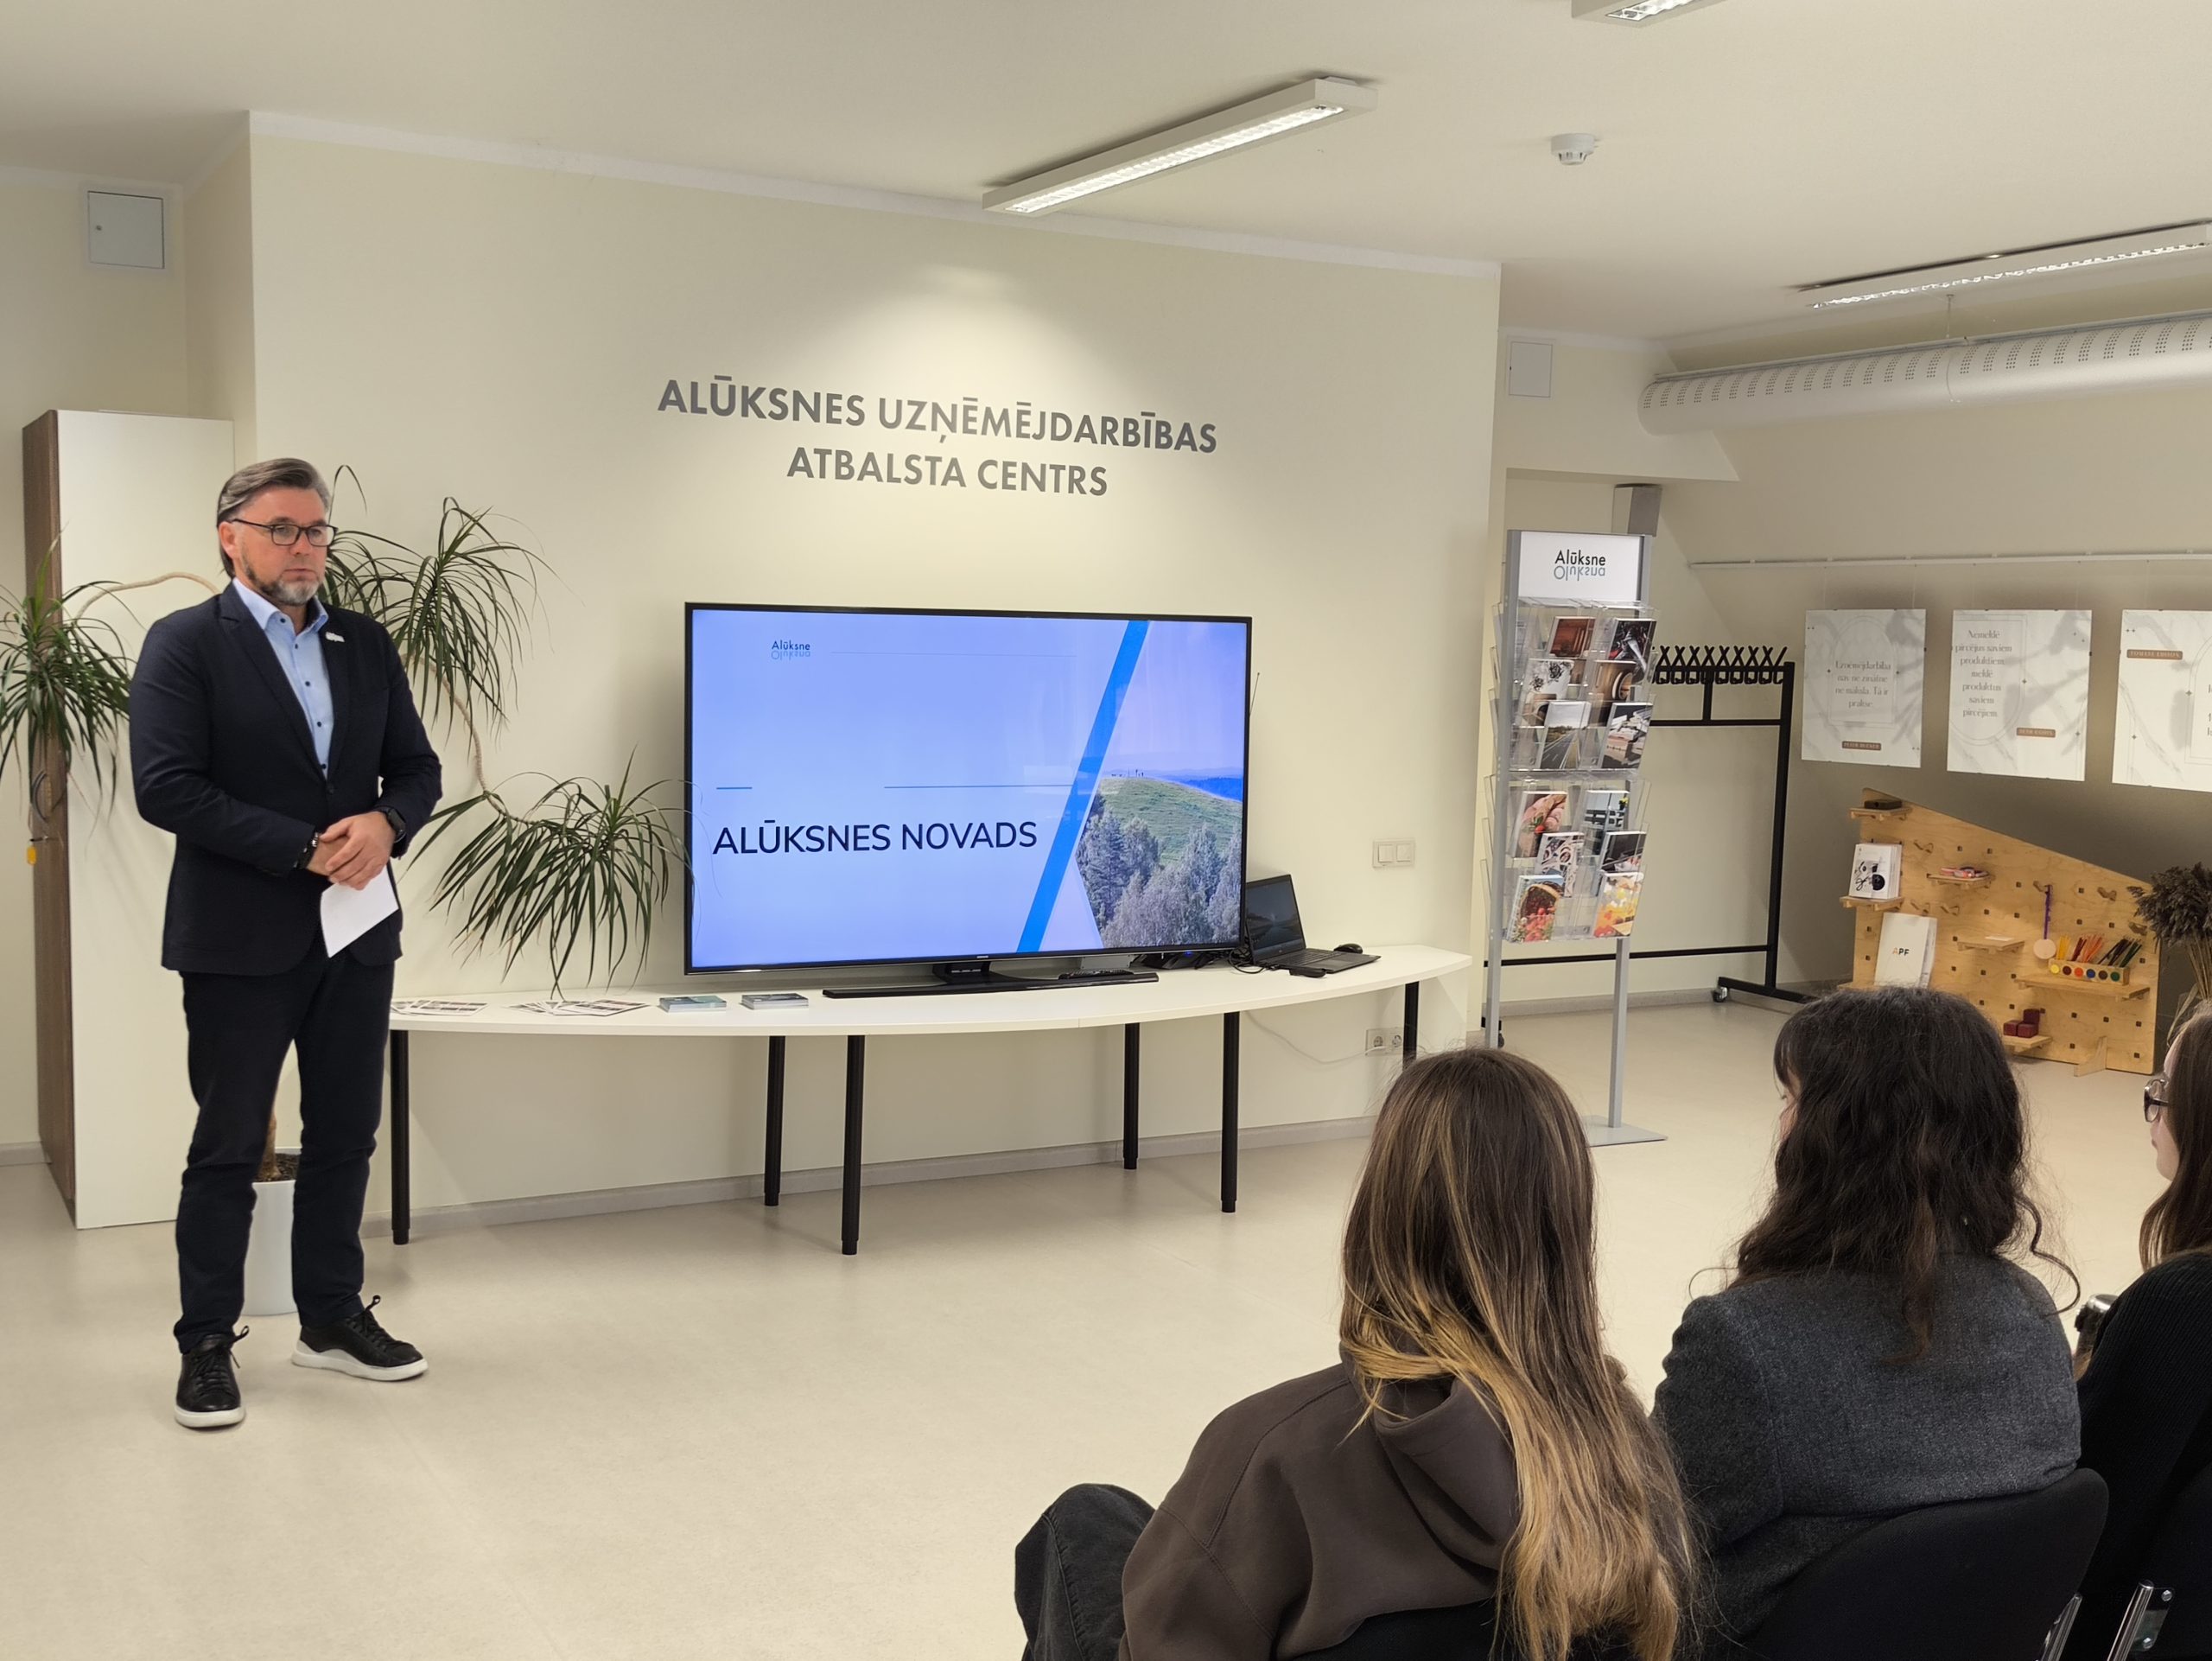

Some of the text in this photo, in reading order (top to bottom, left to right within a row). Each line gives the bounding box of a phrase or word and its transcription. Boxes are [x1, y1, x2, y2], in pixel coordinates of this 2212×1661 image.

[658, 374, 1217, 455] ALŪKSNES UZŅĒMĒJDARBĪBAS
[786, 446, 1109, 497] ATBALSTA CENTRS
[1554, 549, 1606, 566] Alūksne
[771, 640, 810, 651] Alūksne
[712, 819, 1038, 856] ALŪKSNES NOVADS
[1891, 947, 1910, 957] APF
